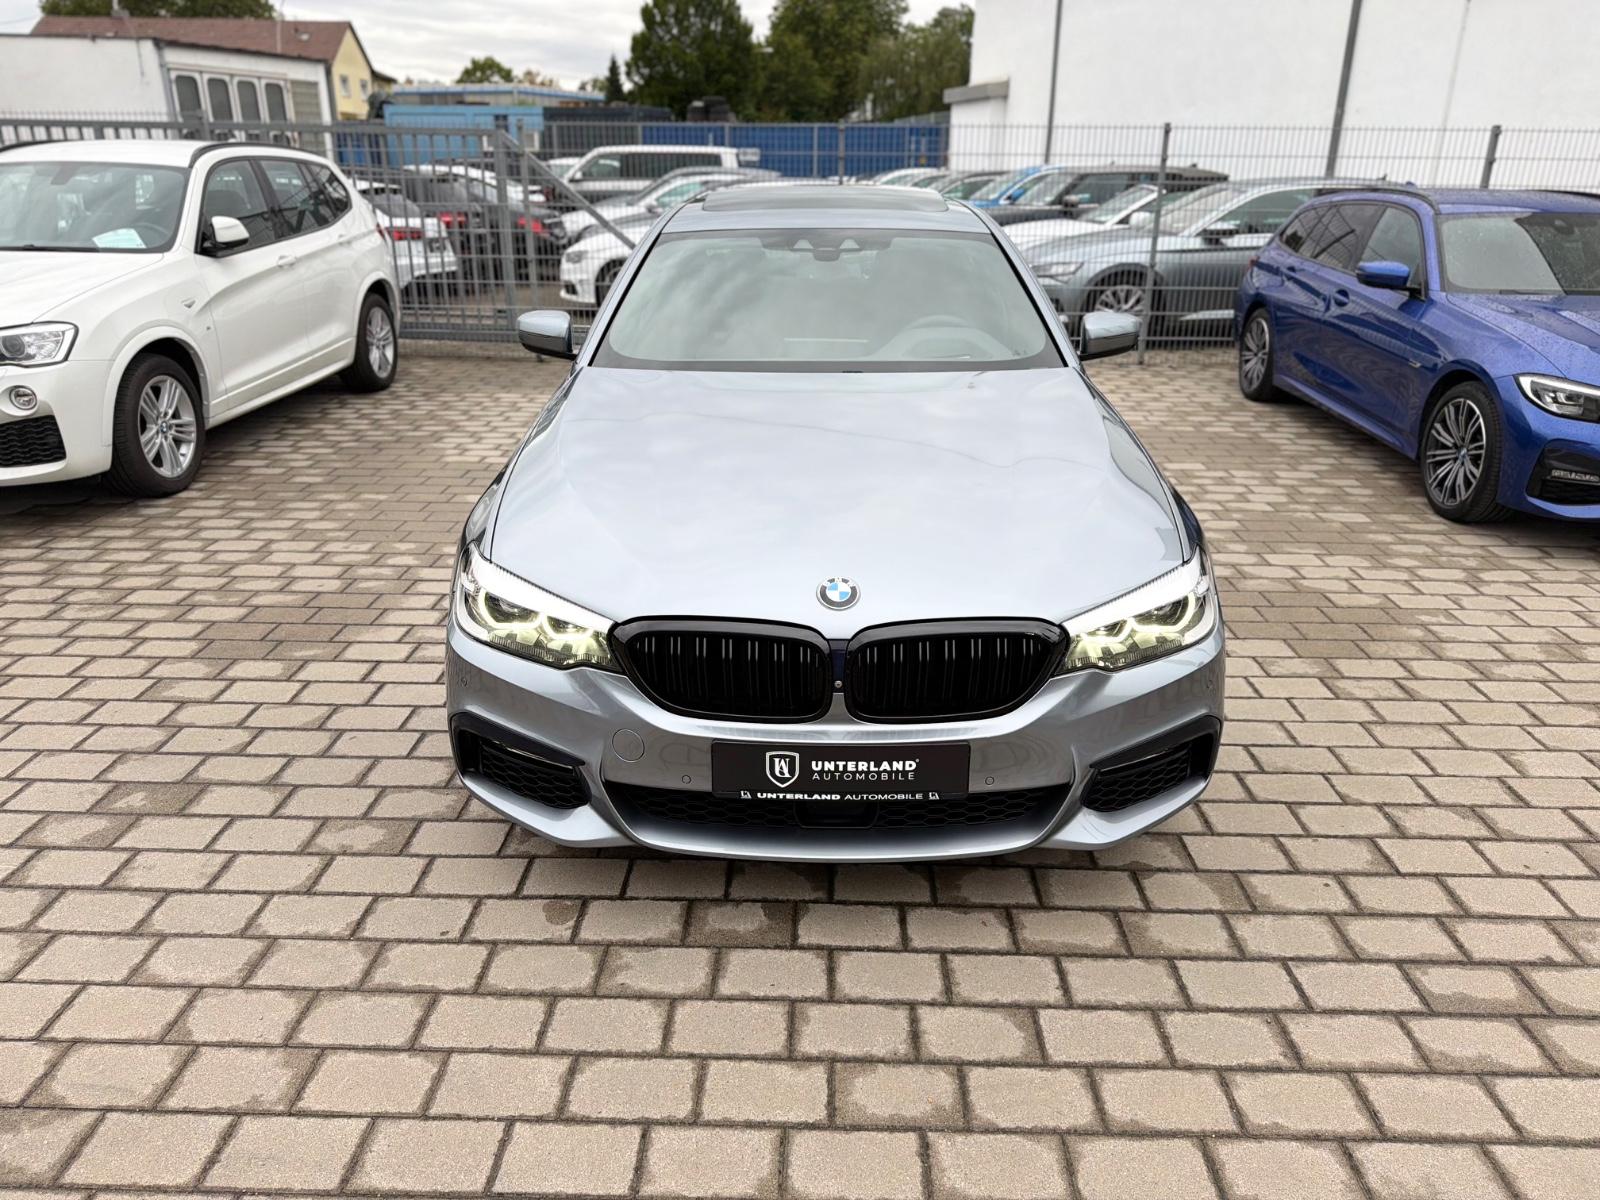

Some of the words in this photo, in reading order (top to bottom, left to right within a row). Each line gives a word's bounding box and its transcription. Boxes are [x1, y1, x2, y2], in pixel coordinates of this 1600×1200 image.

[812, 772, 915, 781] AUTOMOBILE
[757, 792, 841, 801] UNTERLAND
[844, 793, 924, 801] AUTOMOBILE
